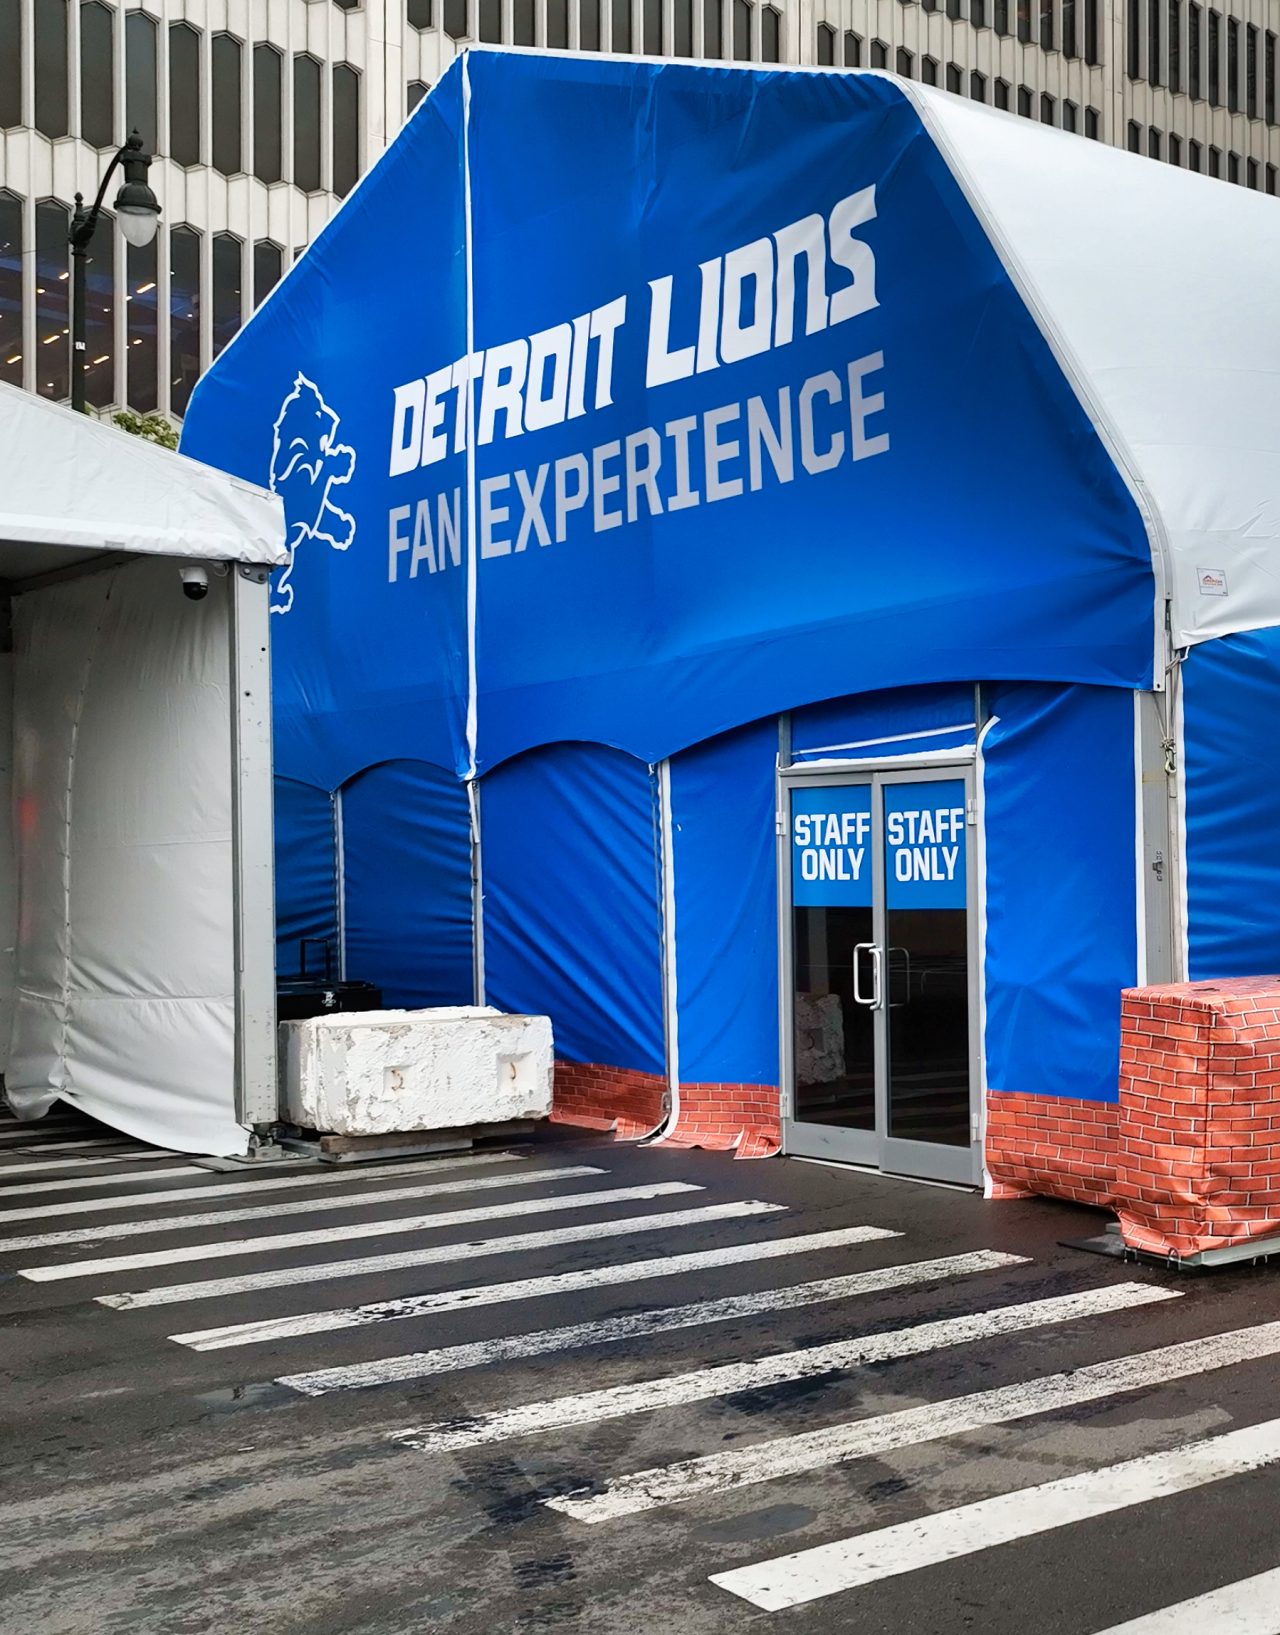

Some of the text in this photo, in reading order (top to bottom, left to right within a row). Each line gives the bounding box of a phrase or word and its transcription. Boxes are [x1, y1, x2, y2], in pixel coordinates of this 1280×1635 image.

[388, 183, 881, 478] DETROIT LIONS
[387, 349, 891, 584] FAN EXPERIENCE
[794, 812, 871, 846] STAFF
[887, 807, 964, 845] STAFF
[801, 847, 865, 881] ONLY
[894, 846, 959, 882] ONLY
